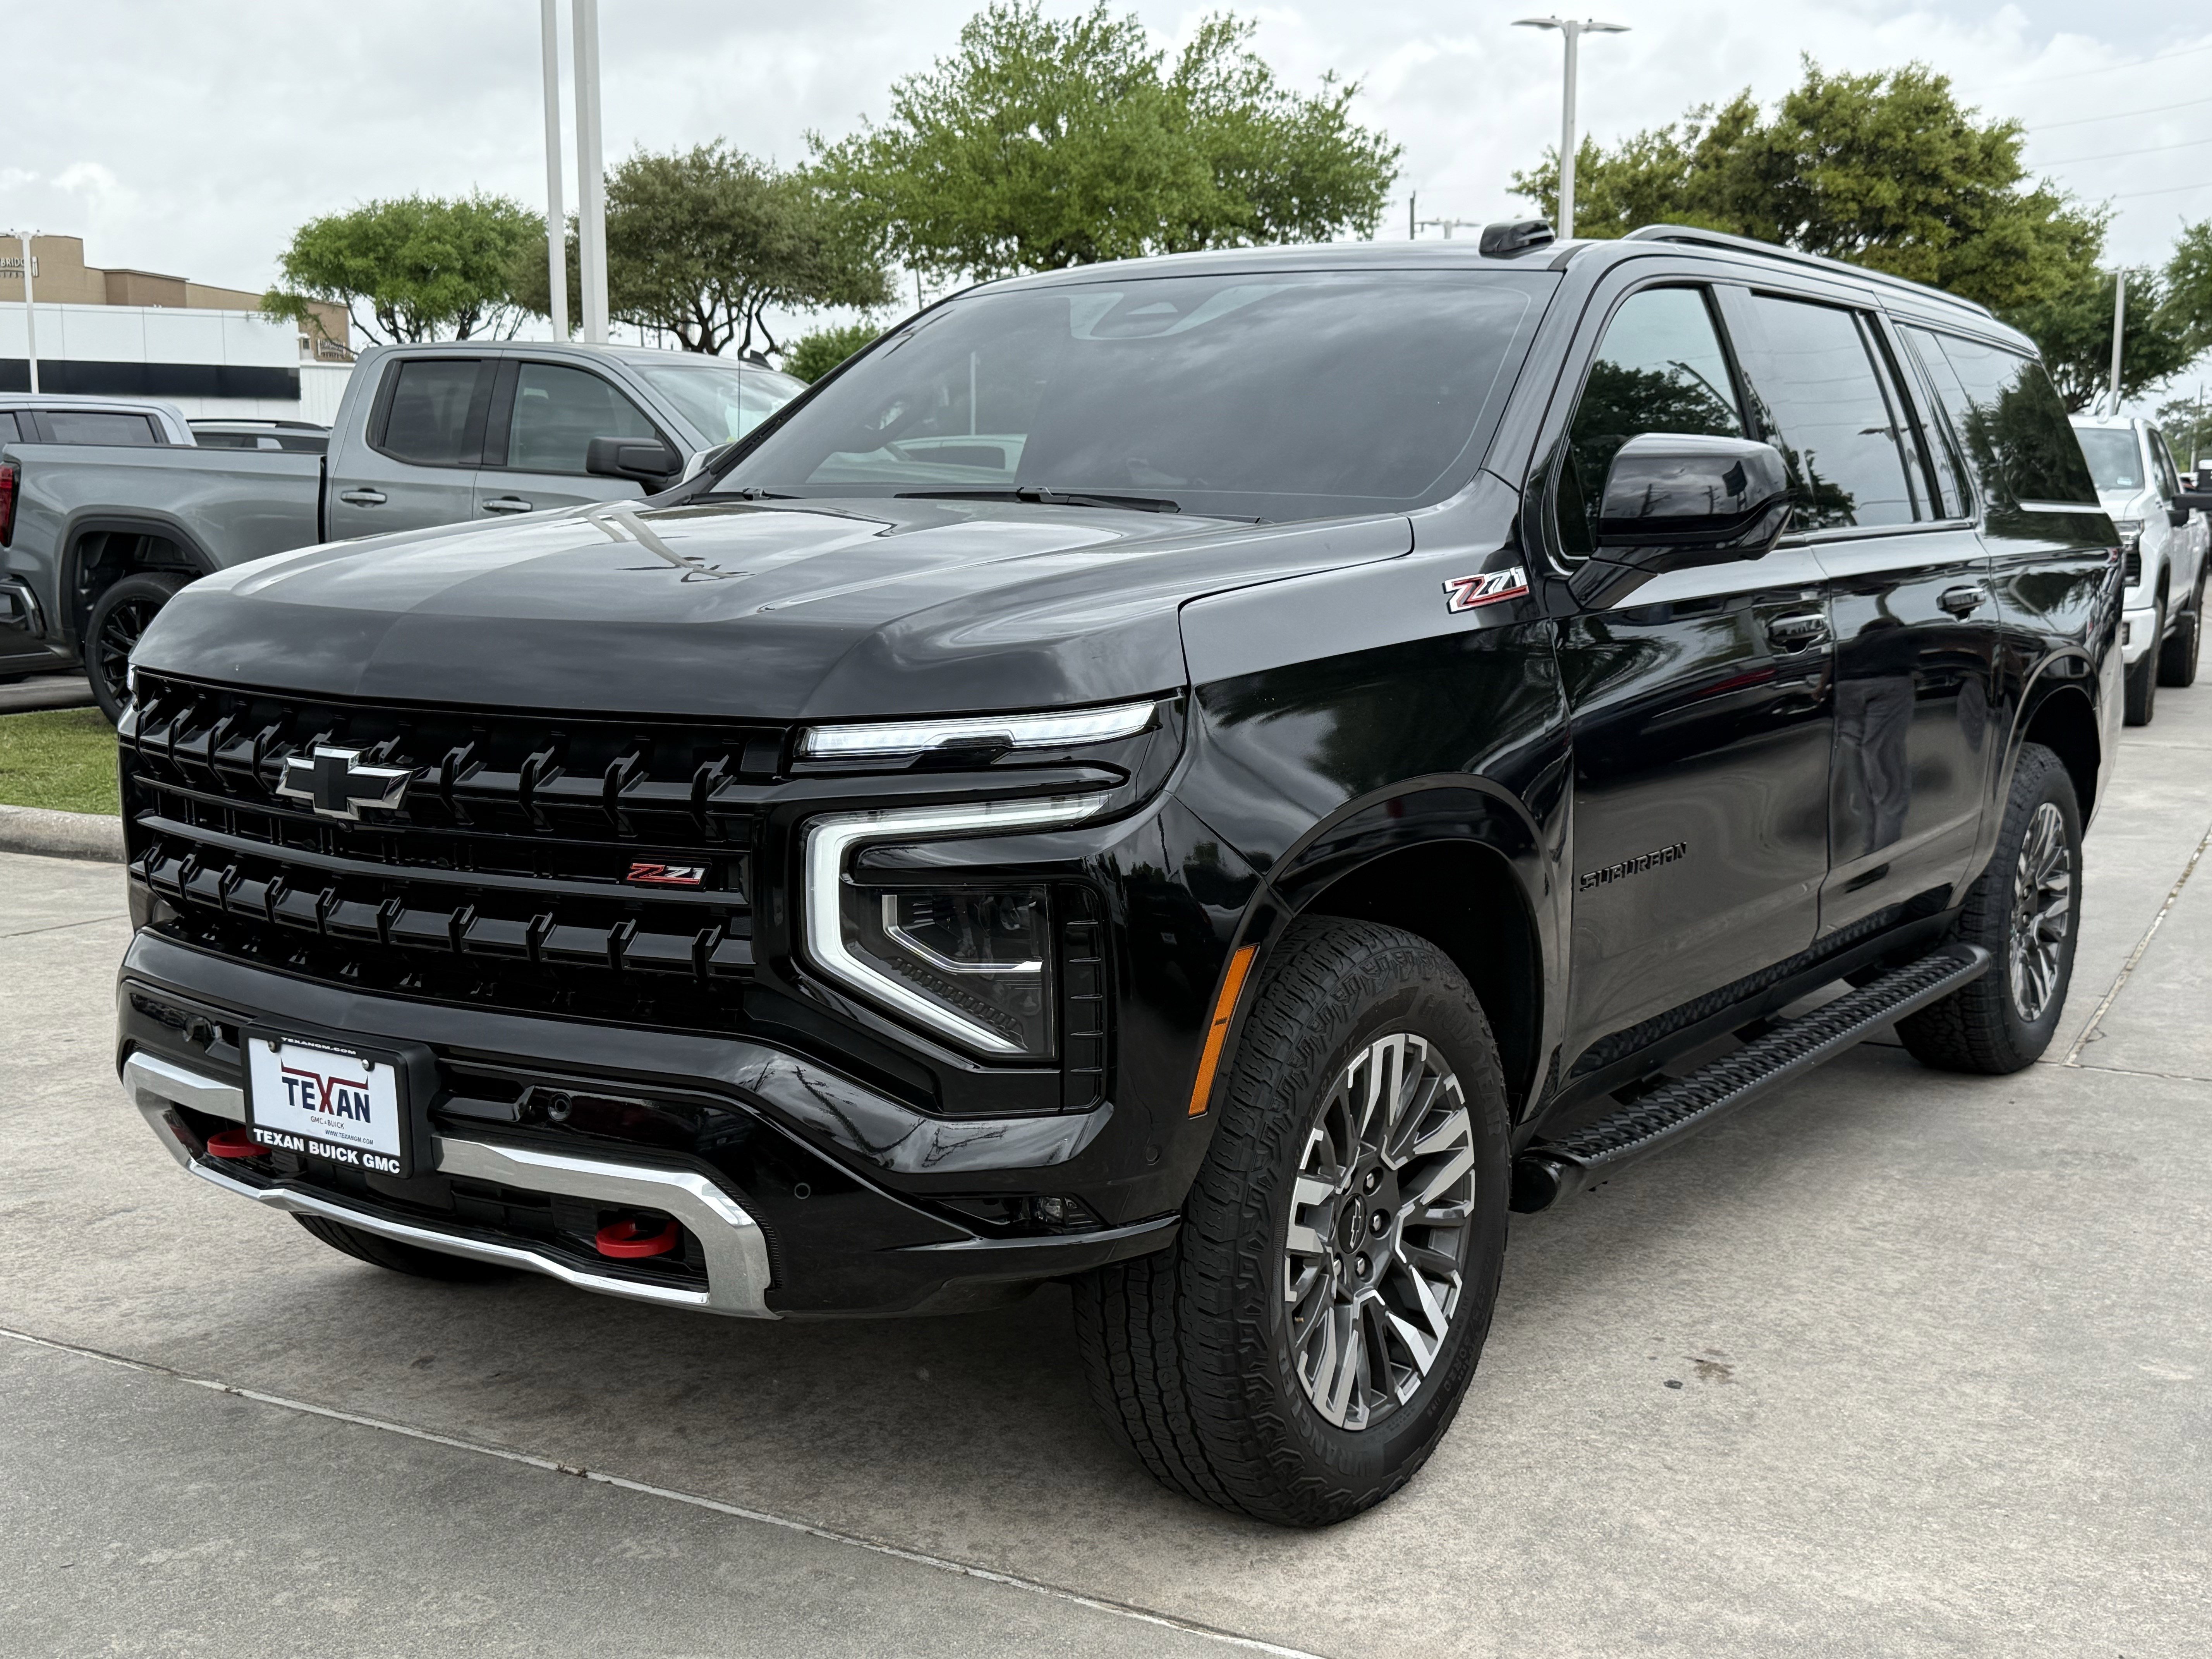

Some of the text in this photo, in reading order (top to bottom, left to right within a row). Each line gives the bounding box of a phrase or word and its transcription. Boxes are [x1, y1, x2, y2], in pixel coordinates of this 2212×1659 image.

[1441, 566, 1529, 614] Z71
[627, 862, 706, 885] Z71
[281, 1066, 371, 1123] TEXAN
[311, 1116, 323, 1125] GMC
[327, 1120, 344, 1129] BUICK
[253, 1128, 400, 1174] TEXAN BUICK GMC
